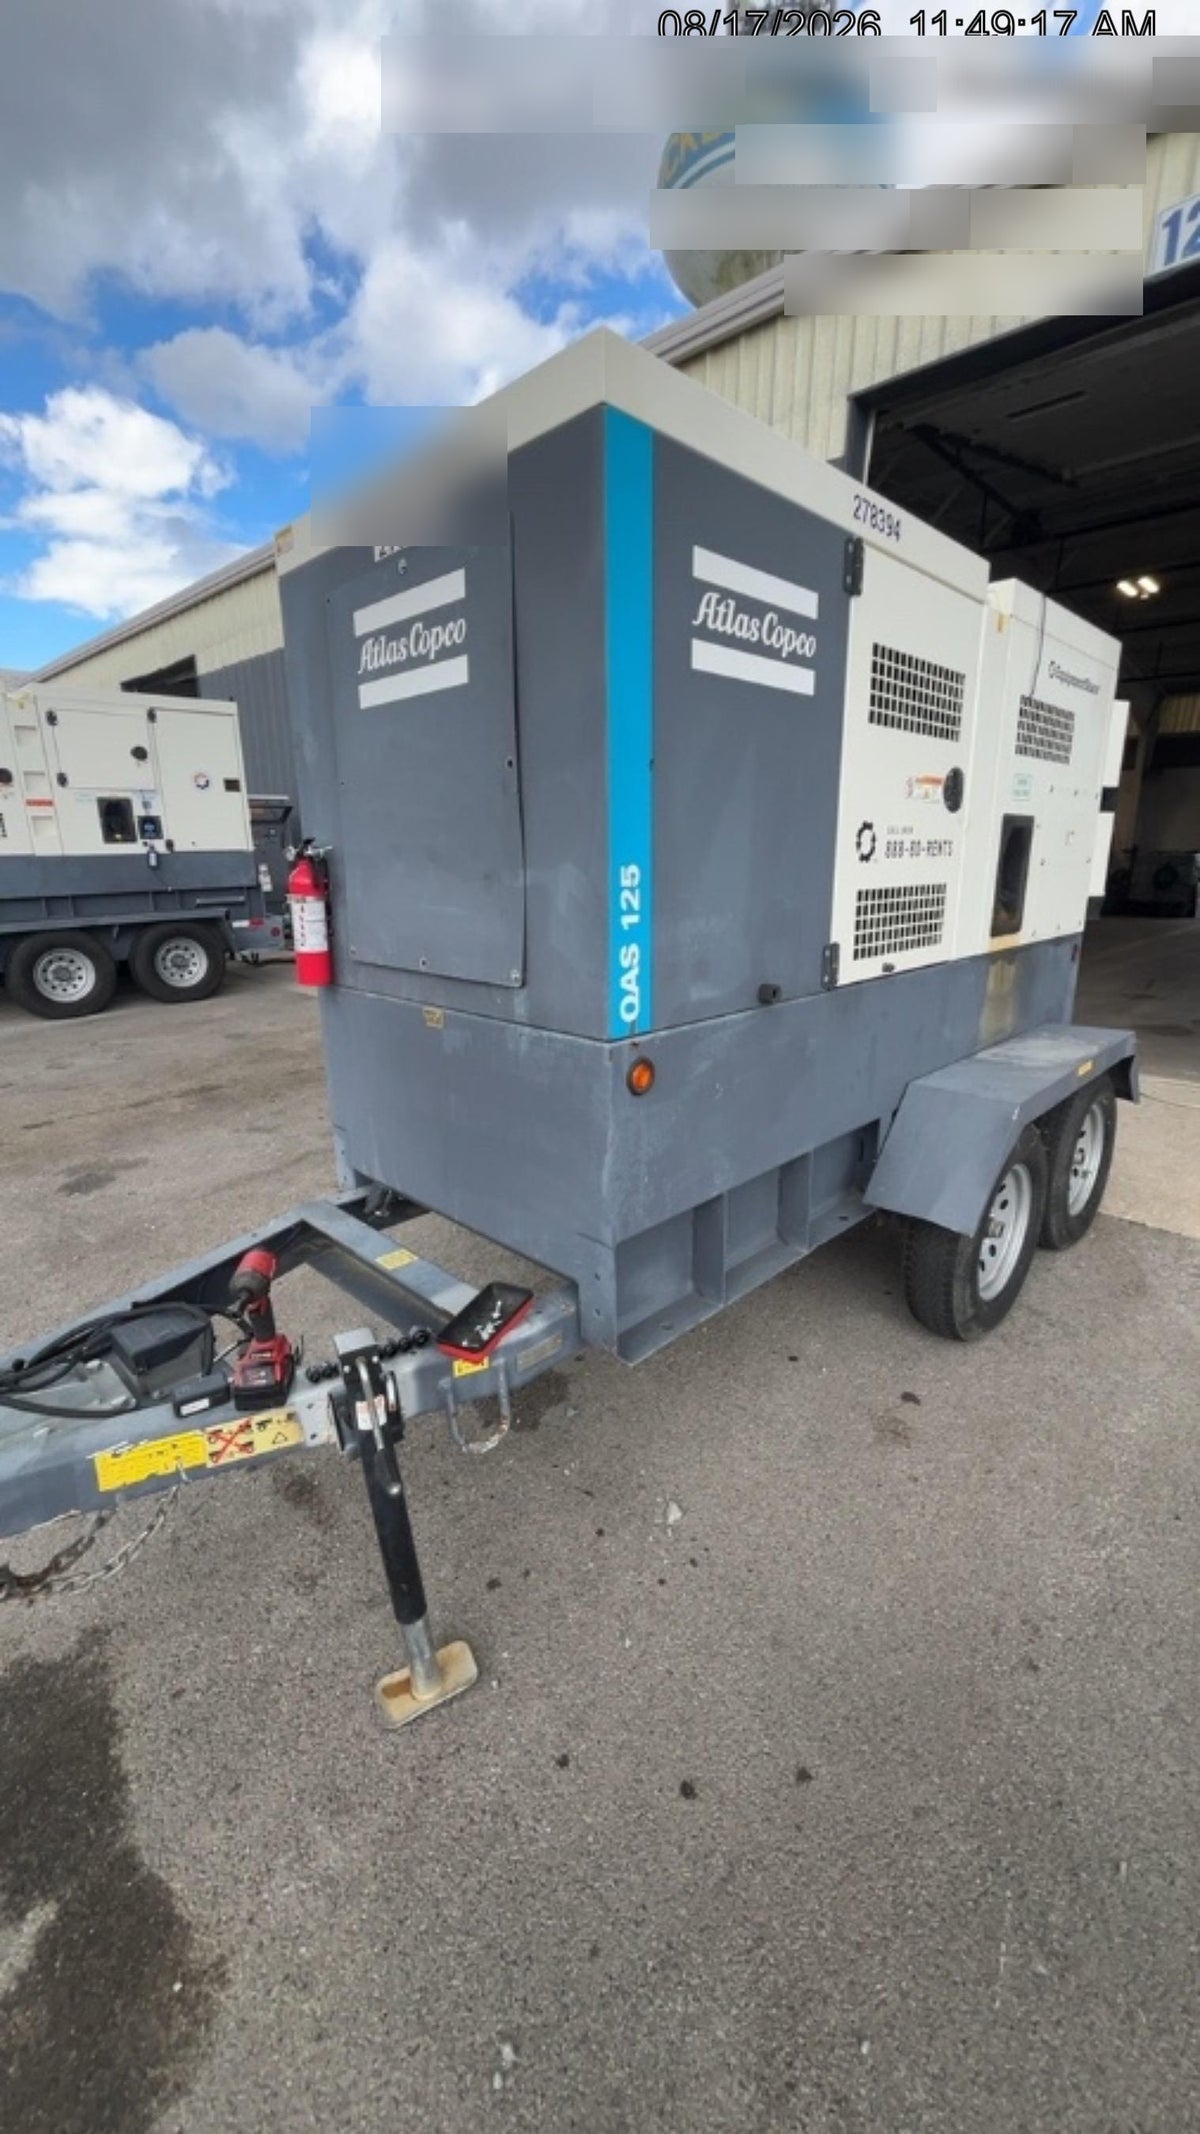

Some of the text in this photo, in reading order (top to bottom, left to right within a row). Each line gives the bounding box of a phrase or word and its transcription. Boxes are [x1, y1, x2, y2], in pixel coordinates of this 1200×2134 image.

[853, 494, 900, 542] 278394
[357, 618, 466, 675] Atlas Copco
[692, 591, 817, 658] Atlas Copco
[619, 864, 641, 1024] QAS 125
